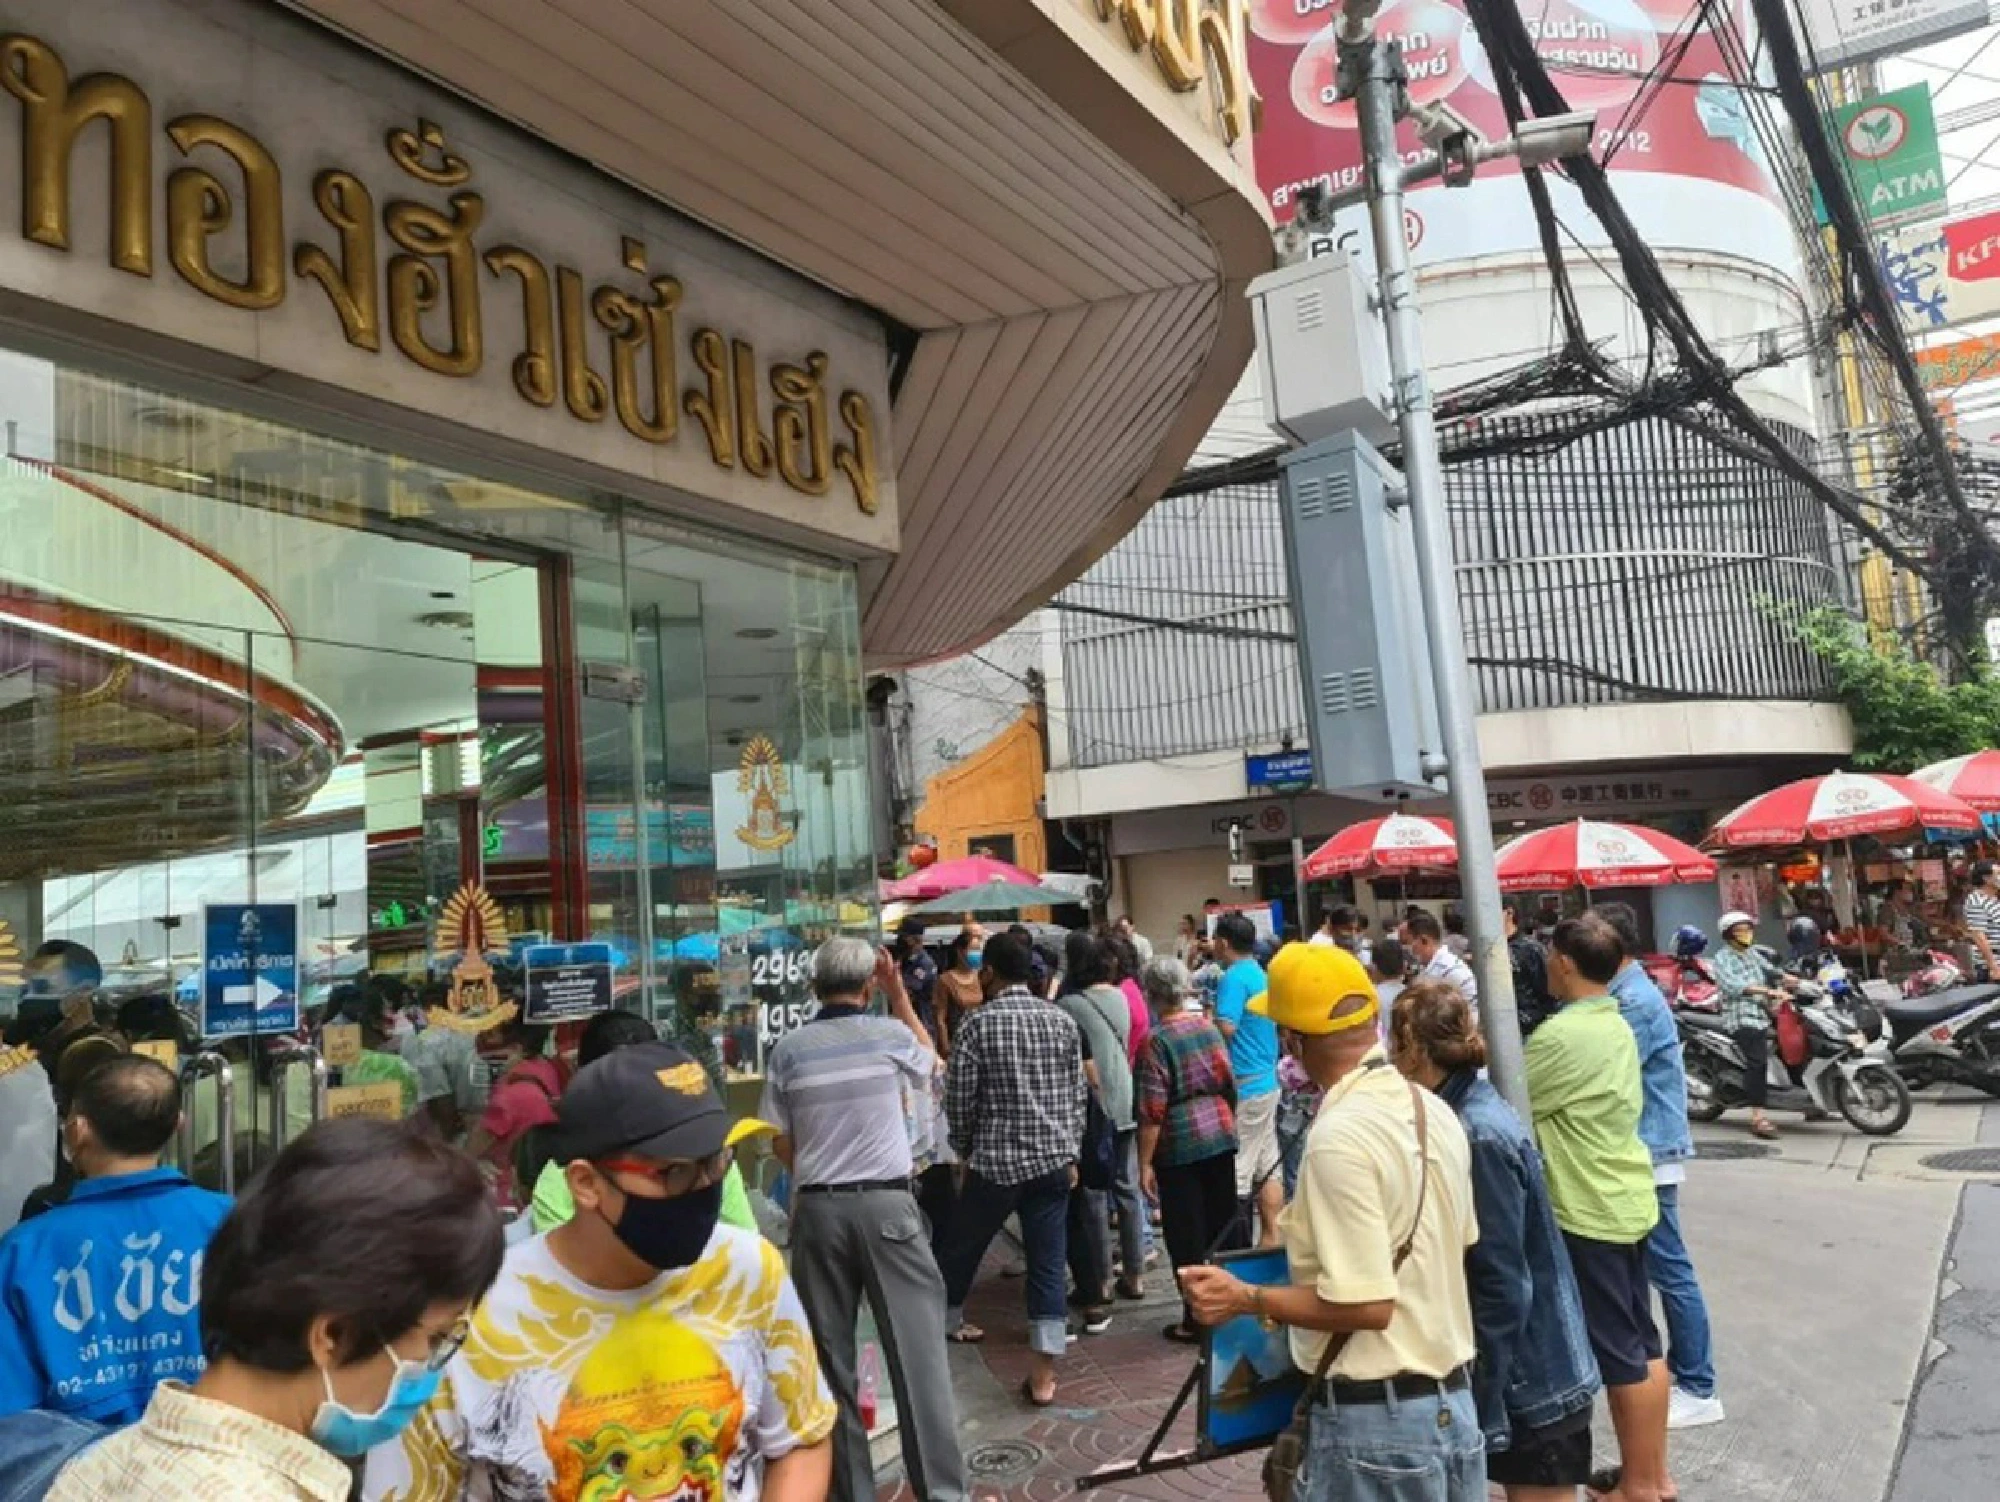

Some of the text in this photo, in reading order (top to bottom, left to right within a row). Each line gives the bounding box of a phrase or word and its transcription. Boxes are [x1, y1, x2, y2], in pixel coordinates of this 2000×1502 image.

[1871, 169, 1940, 206] ATM
[1, 32, 877, 517] ทองฮั่วเซ่งเฮง
[1486, 790, 1524, 809] CBC
